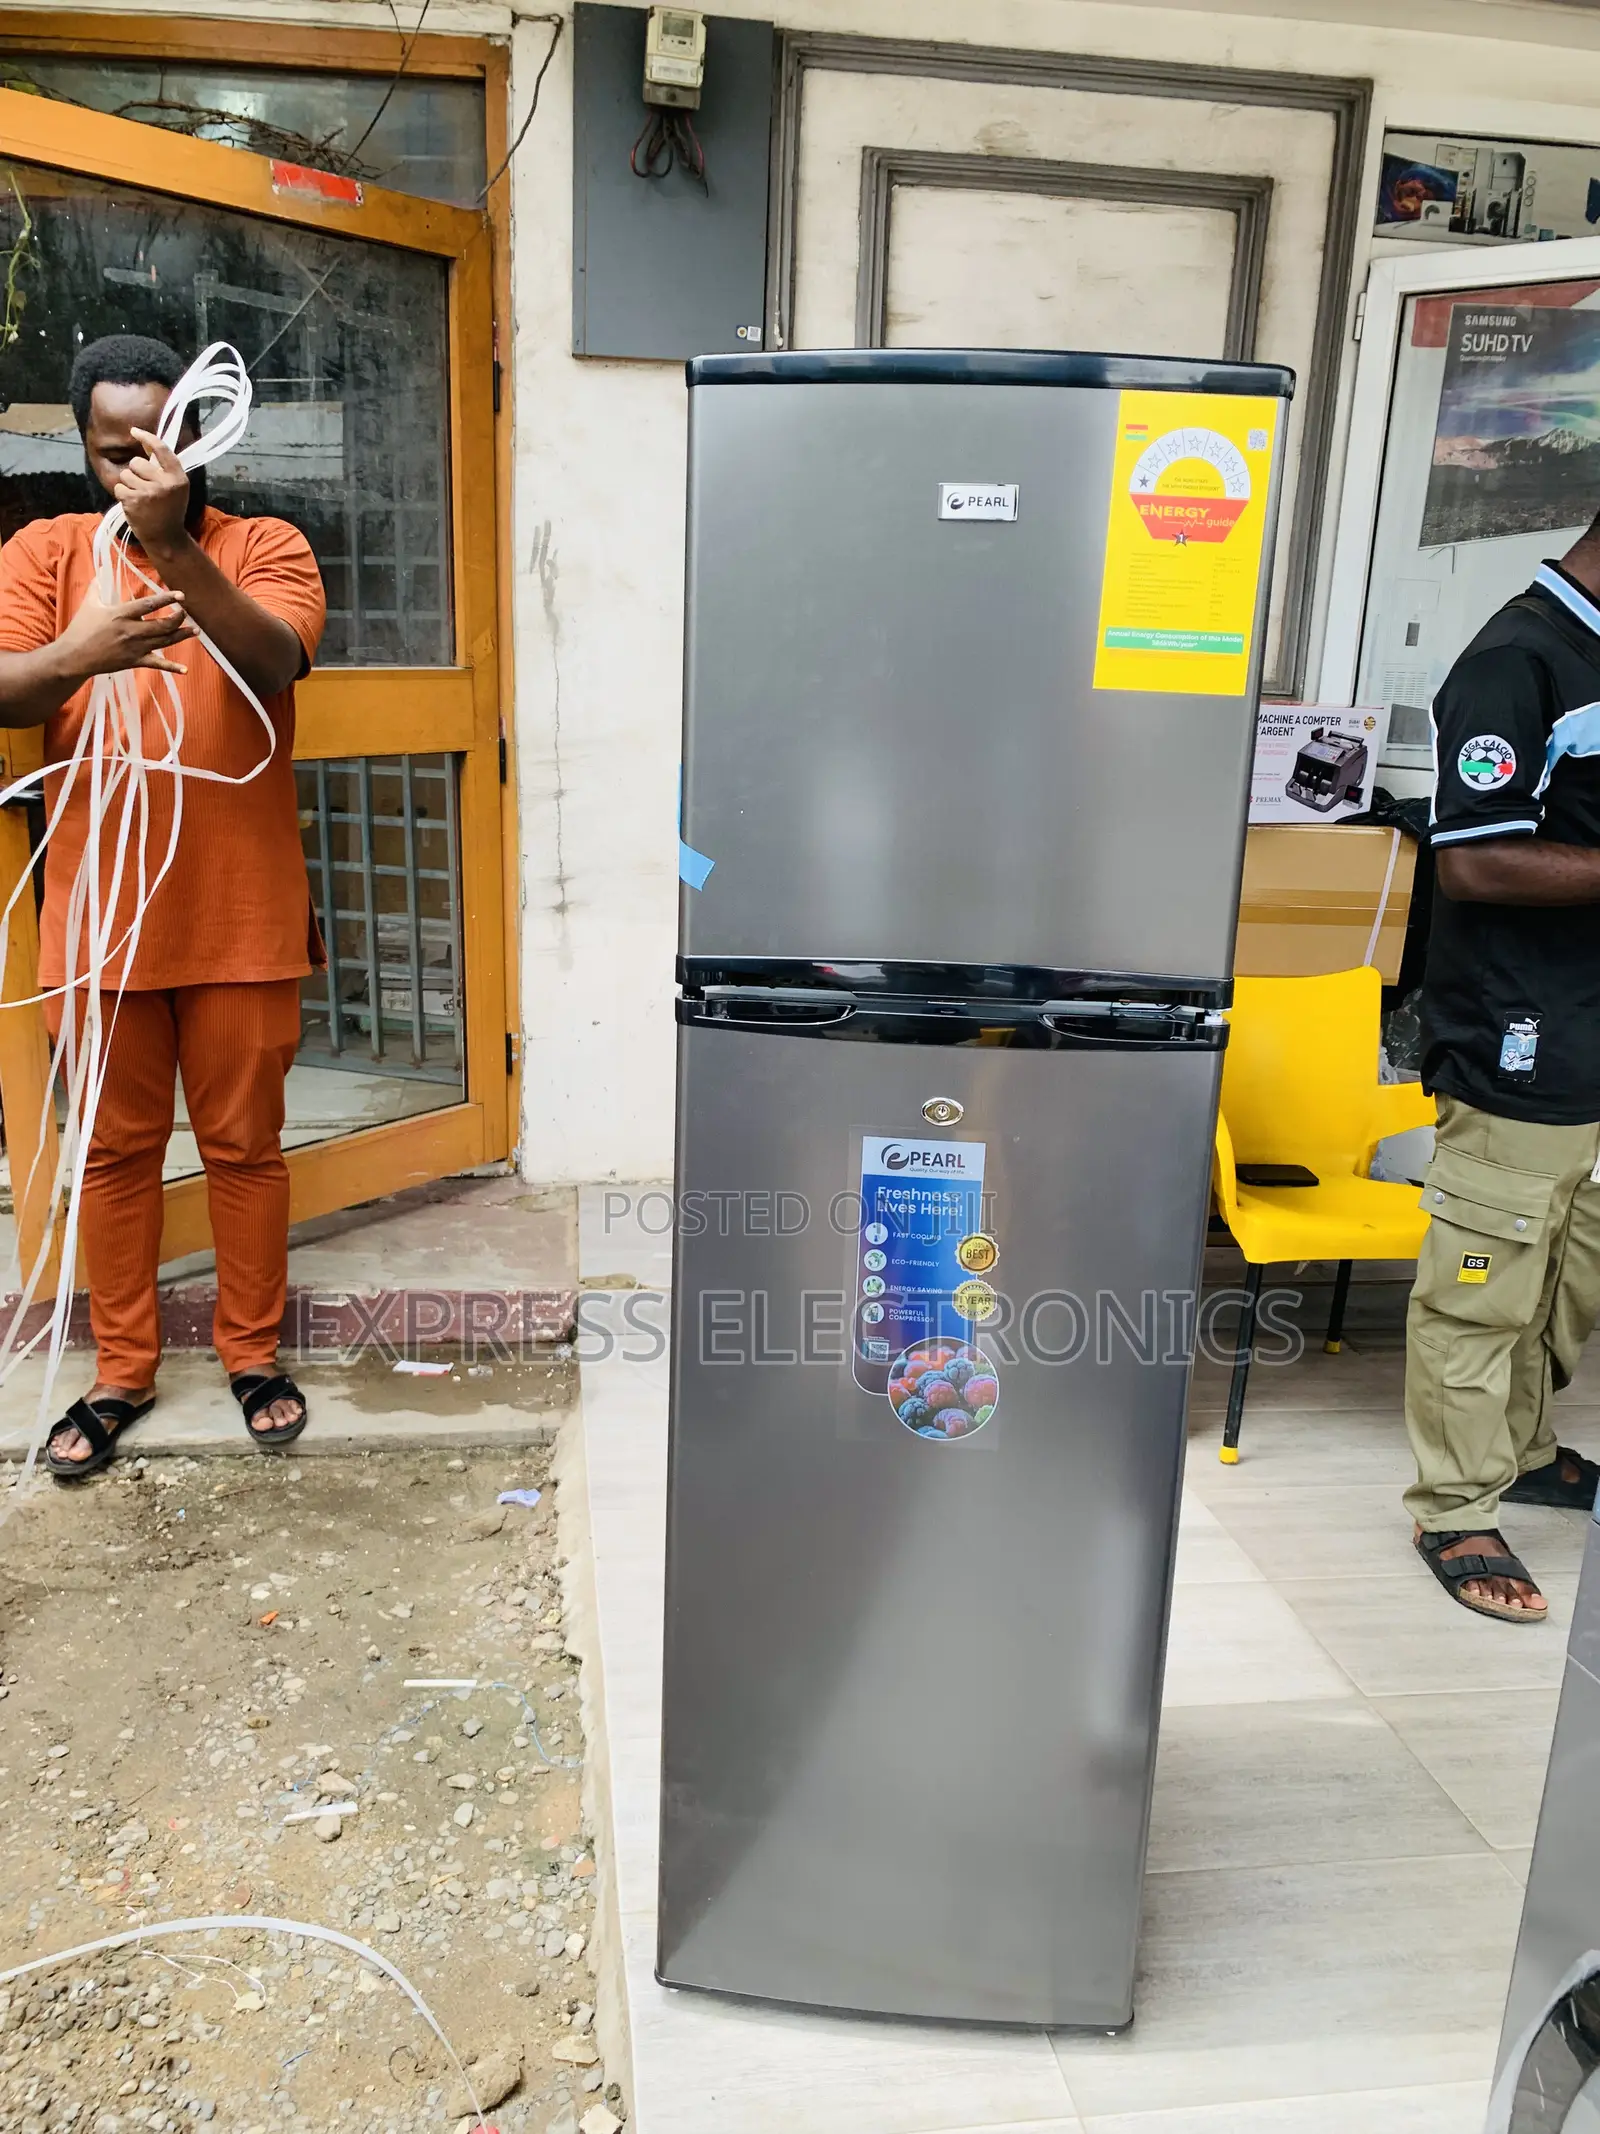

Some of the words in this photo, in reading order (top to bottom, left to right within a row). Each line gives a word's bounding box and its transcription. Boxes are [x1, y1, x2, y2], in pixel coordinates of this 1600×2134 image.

[1464, 314, 1517, 327] SAMSUNG
[1460, 333, 1509, 352] SUHD
[1511, 334, 1534, 352] TV
[968, 496, 1009, 508] PEARL
[1139, 502, 1212, 520] ENERGY
[1206, 517, 1236, 528] guide
[1131, 631, 1154, 640] Energy
[1155, 633, 1199, 642] Consumption
[1257, 715, 1295, 725] MACHINE
[1295, 716, 1301, 725] A
[1302, 716, 1341, 726] COMPTER
[1257, 727, 1295, 737] 'ARGENT
[1461, 740, 1481, 758] LEGA
[1483, 739, 1512, 760] CALCIO
[1509, 1022, 1534, 1031] PUMA
[910, 1151, 966, 1169] PEARL
[878, 1186, 963, 1202] Freshness
[877, 1199, 917, 1215] Lives
[920, 1202, 963, 1217] Here!
[965, 1249, 990, 1260] BEST
[891, 1258, 940, 1267] ECO-FRIENDLY
[1467, 1258, 1485, 1268] GS
[890, 1284, 916, 1293] ENERGY
[964, 1296, 991, 1305] YEAR
[889, 1308, 924, 1316] POWERFUL
[888, 1315, 935, 1323] COMPRESSOR
